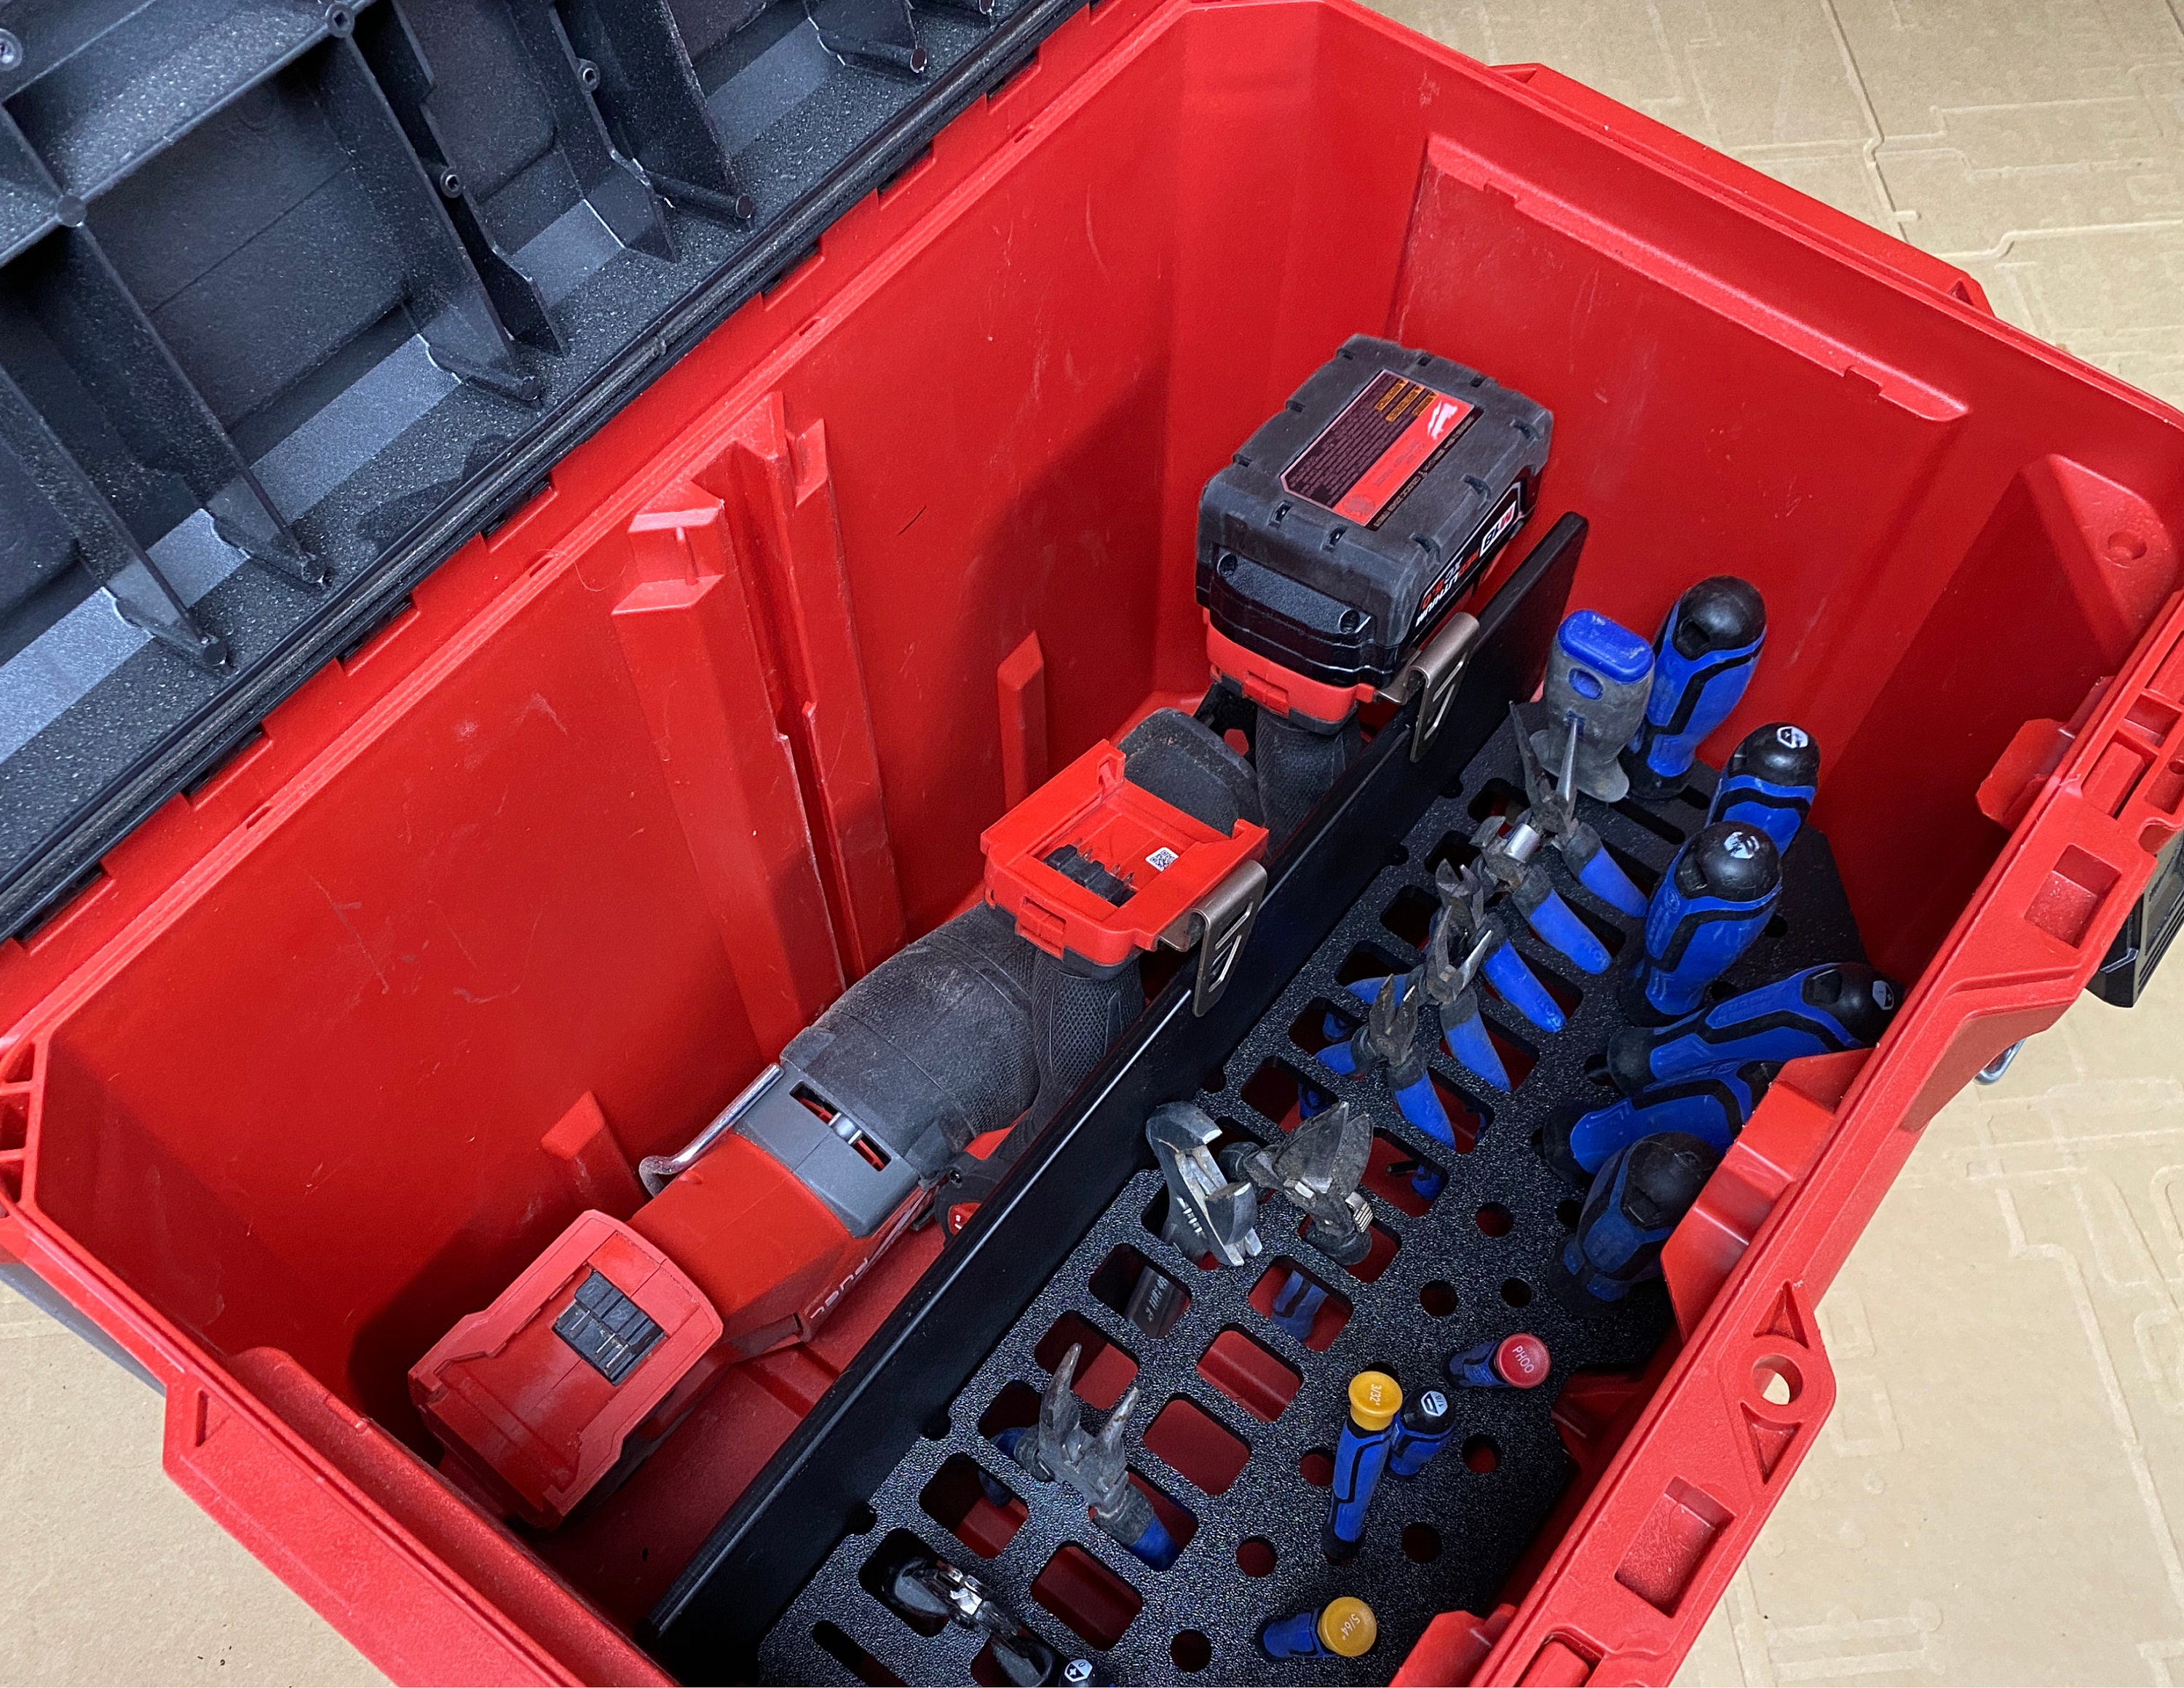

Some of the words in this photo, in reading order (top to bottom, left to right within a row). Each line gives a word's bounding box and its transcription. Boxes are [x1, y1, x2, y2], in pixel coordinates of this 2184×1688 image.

[1485, 507, 1514, 545] M18
[810, 1257, 868, 1319] FUEL
[1369, 1384, 1382, 1406] 3/32"
[1340, 1614, 1361, 1641] 5/64"
